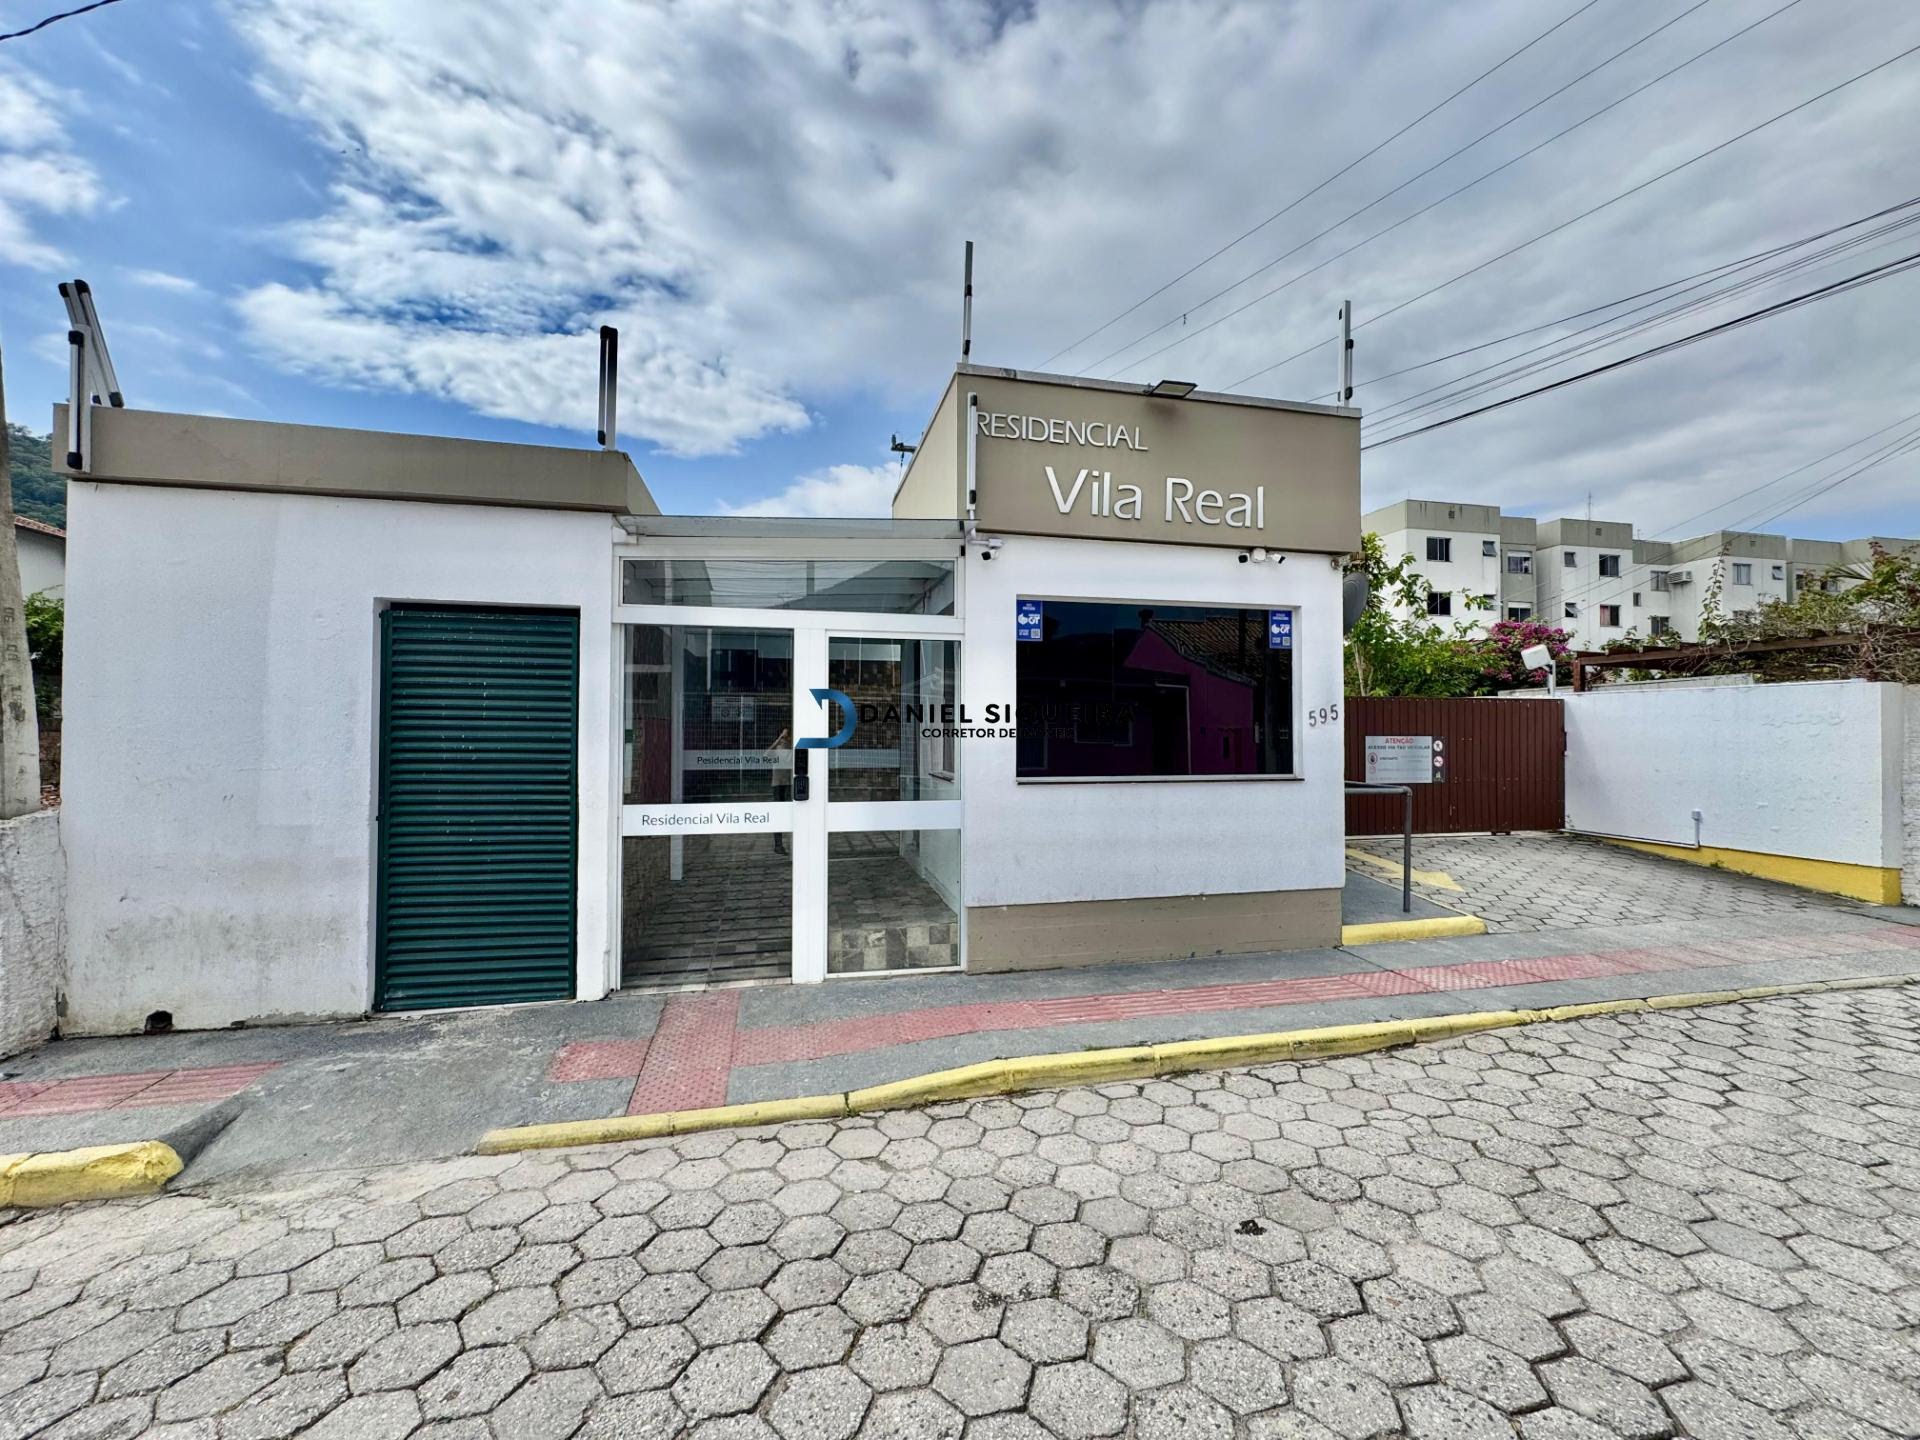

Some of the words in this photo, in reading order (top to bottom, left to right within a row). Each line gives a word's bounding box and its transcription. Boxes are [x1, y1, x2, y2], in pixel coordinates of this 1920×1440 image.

[977, 411, 1148, 452] RESIDENCIAL
[1045, 466, 1142, 520] Vila
[1165, 477, 1265, 530] Real
[1308, 704, 1339, 728] 595
[744, 755, 760, 765] Vila
[763, 755, 780, 765] Real
[642, 813, 713, 826] Residencial
[717, 811, 740, 825] Vila
[744, 812, 770, 824] Real
